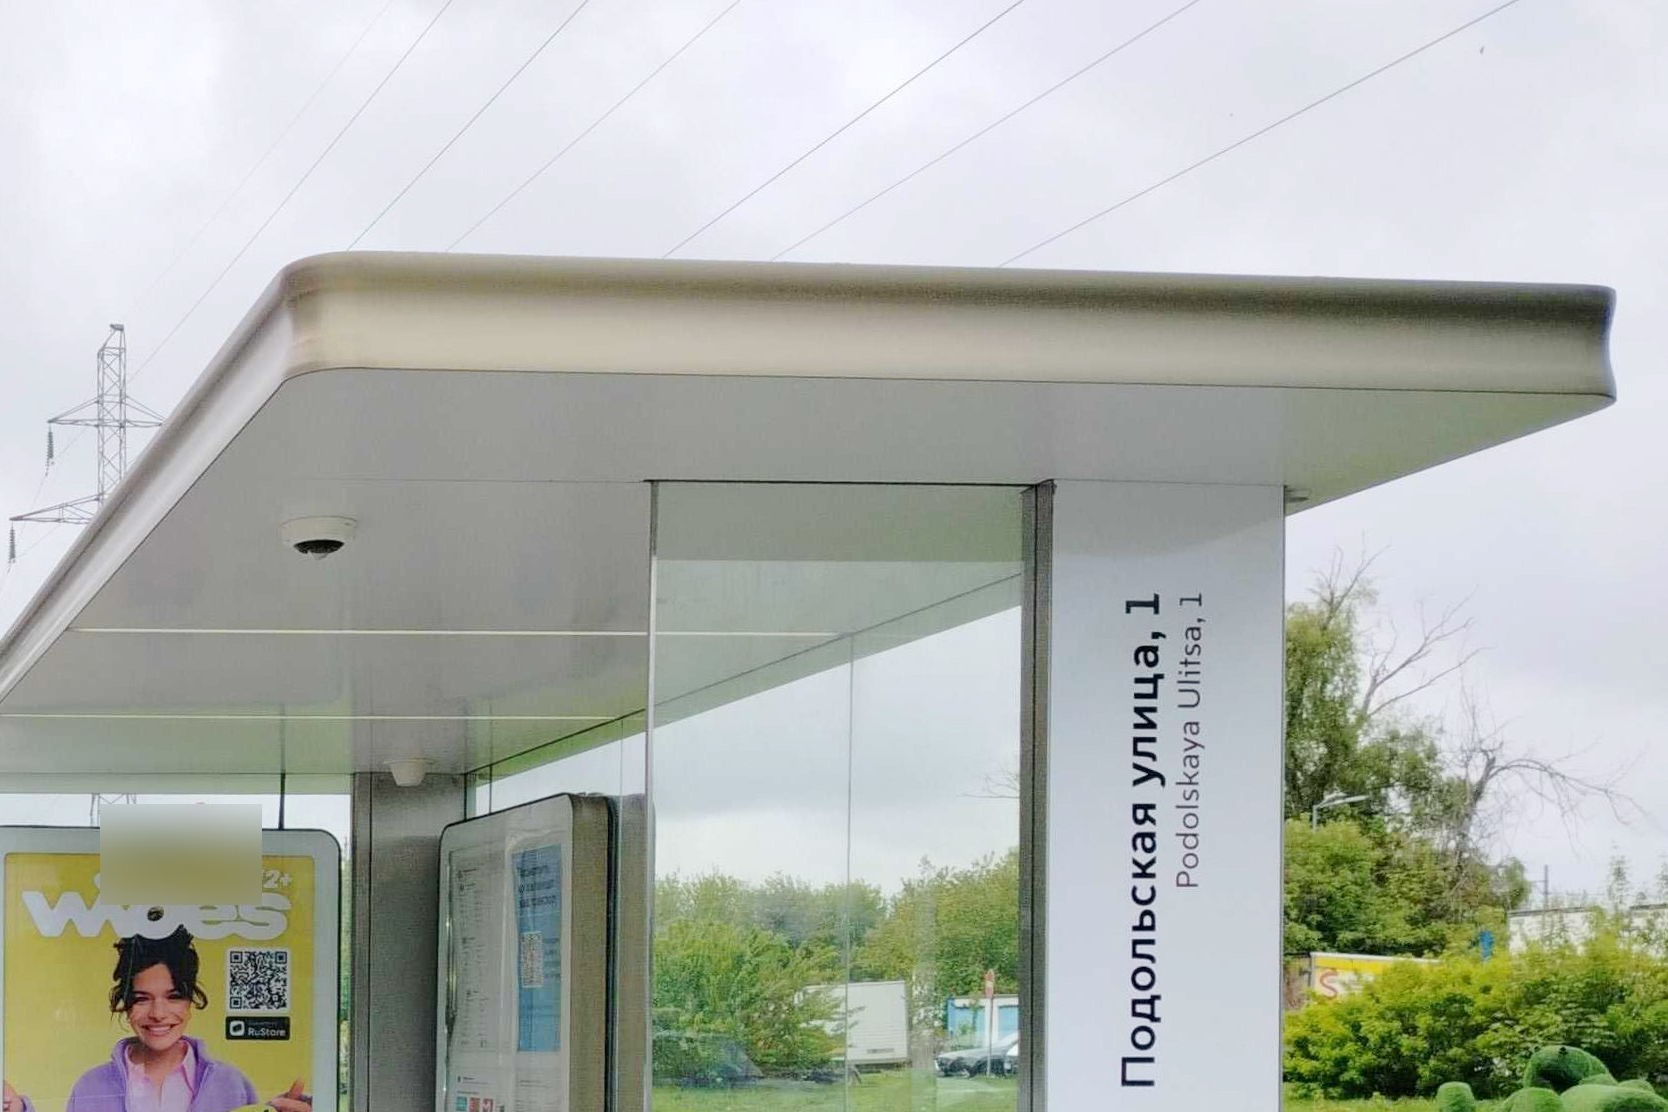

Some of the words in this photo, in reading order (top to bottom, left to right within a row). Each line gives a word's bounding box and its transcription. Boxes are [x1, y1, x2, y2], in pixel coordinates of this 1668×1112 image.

[1125, 592, 1160, 615] 1
[1178, 592, 1203, 607] 1
[1176, 617, 1207, 708] Ulitsa,
[1132, 631, 1167, 788] улица,
[1175, 720, 1206, 888] Podolskaya
[261, 869, 294, 889] 2+
[1121, 803, 1162, 1088] Подольская
[247, 1026, 286, 1037] RuStore
